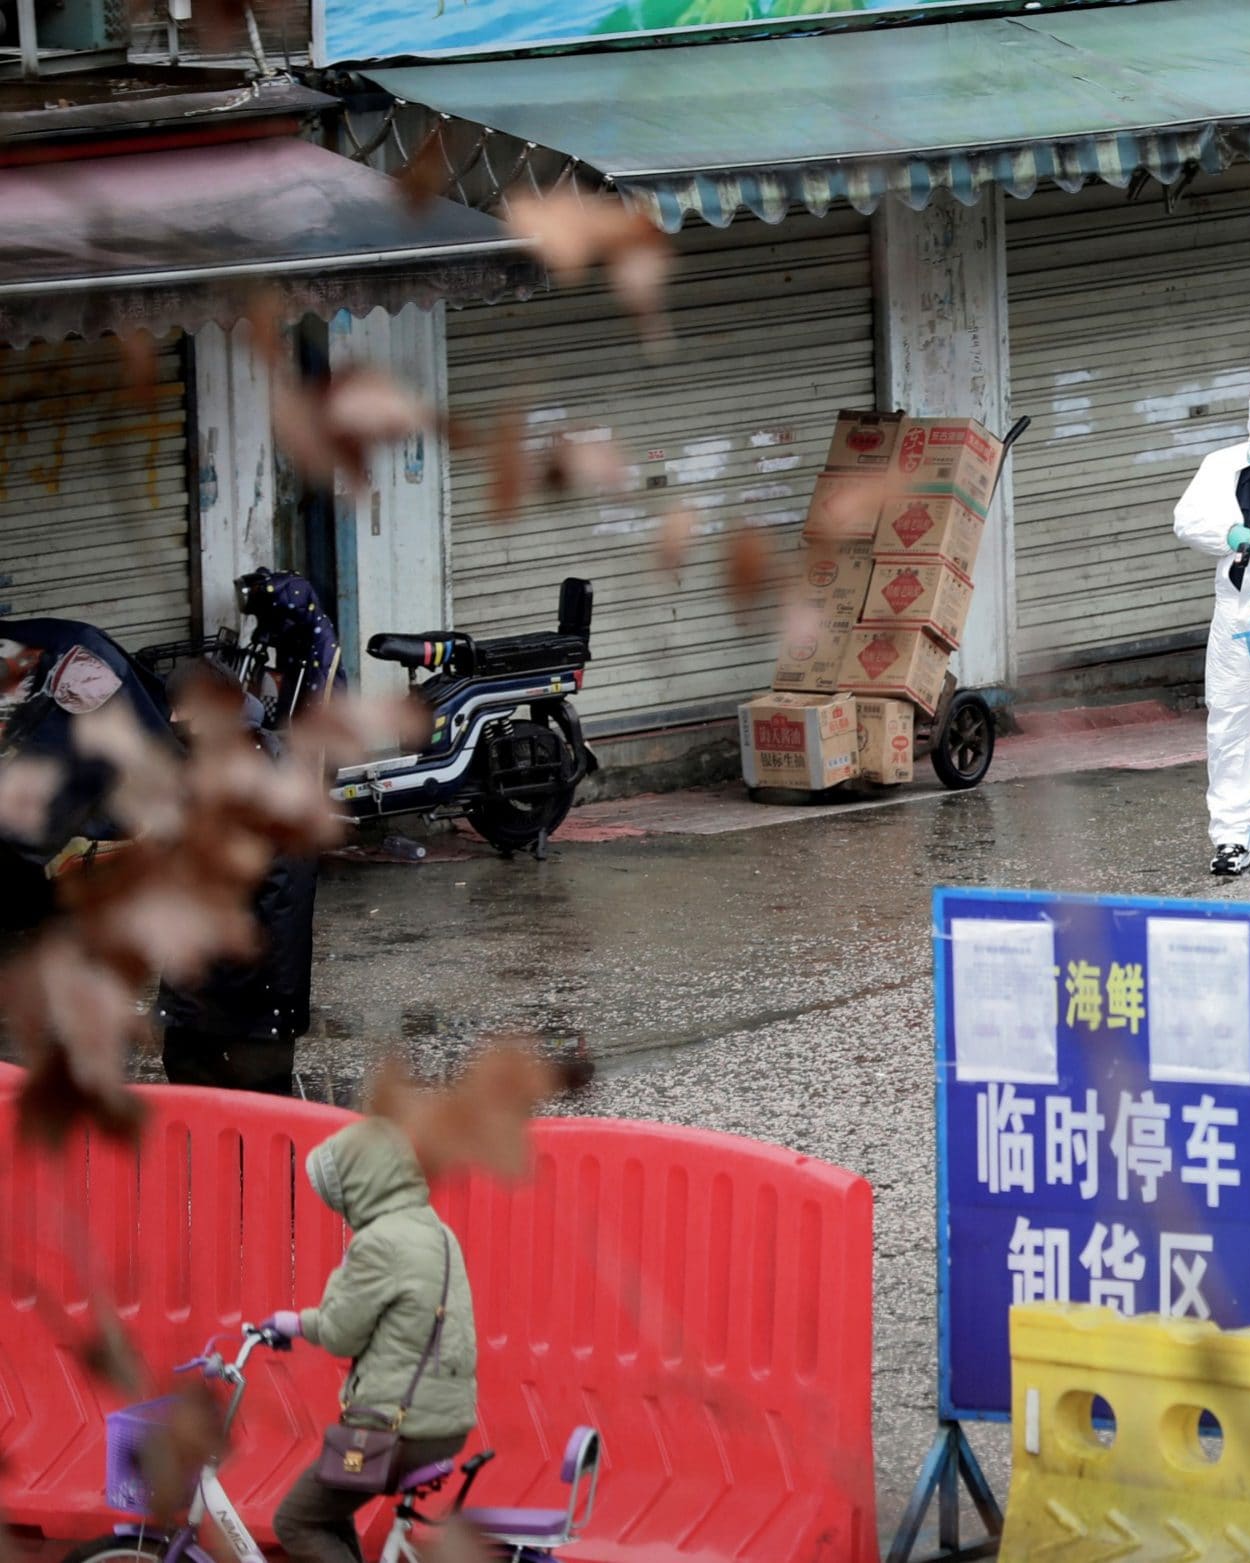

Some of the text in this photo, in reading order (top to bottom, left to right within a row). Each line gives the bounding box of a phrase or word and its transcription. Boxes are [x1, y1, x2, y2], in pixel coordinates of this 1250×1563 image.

[1051, 960, 1146, 1035] 海鲜
[977, 1082, 1241, 1208] 临时停车
[1008, 1216, 1214, 1319] 卸货区
